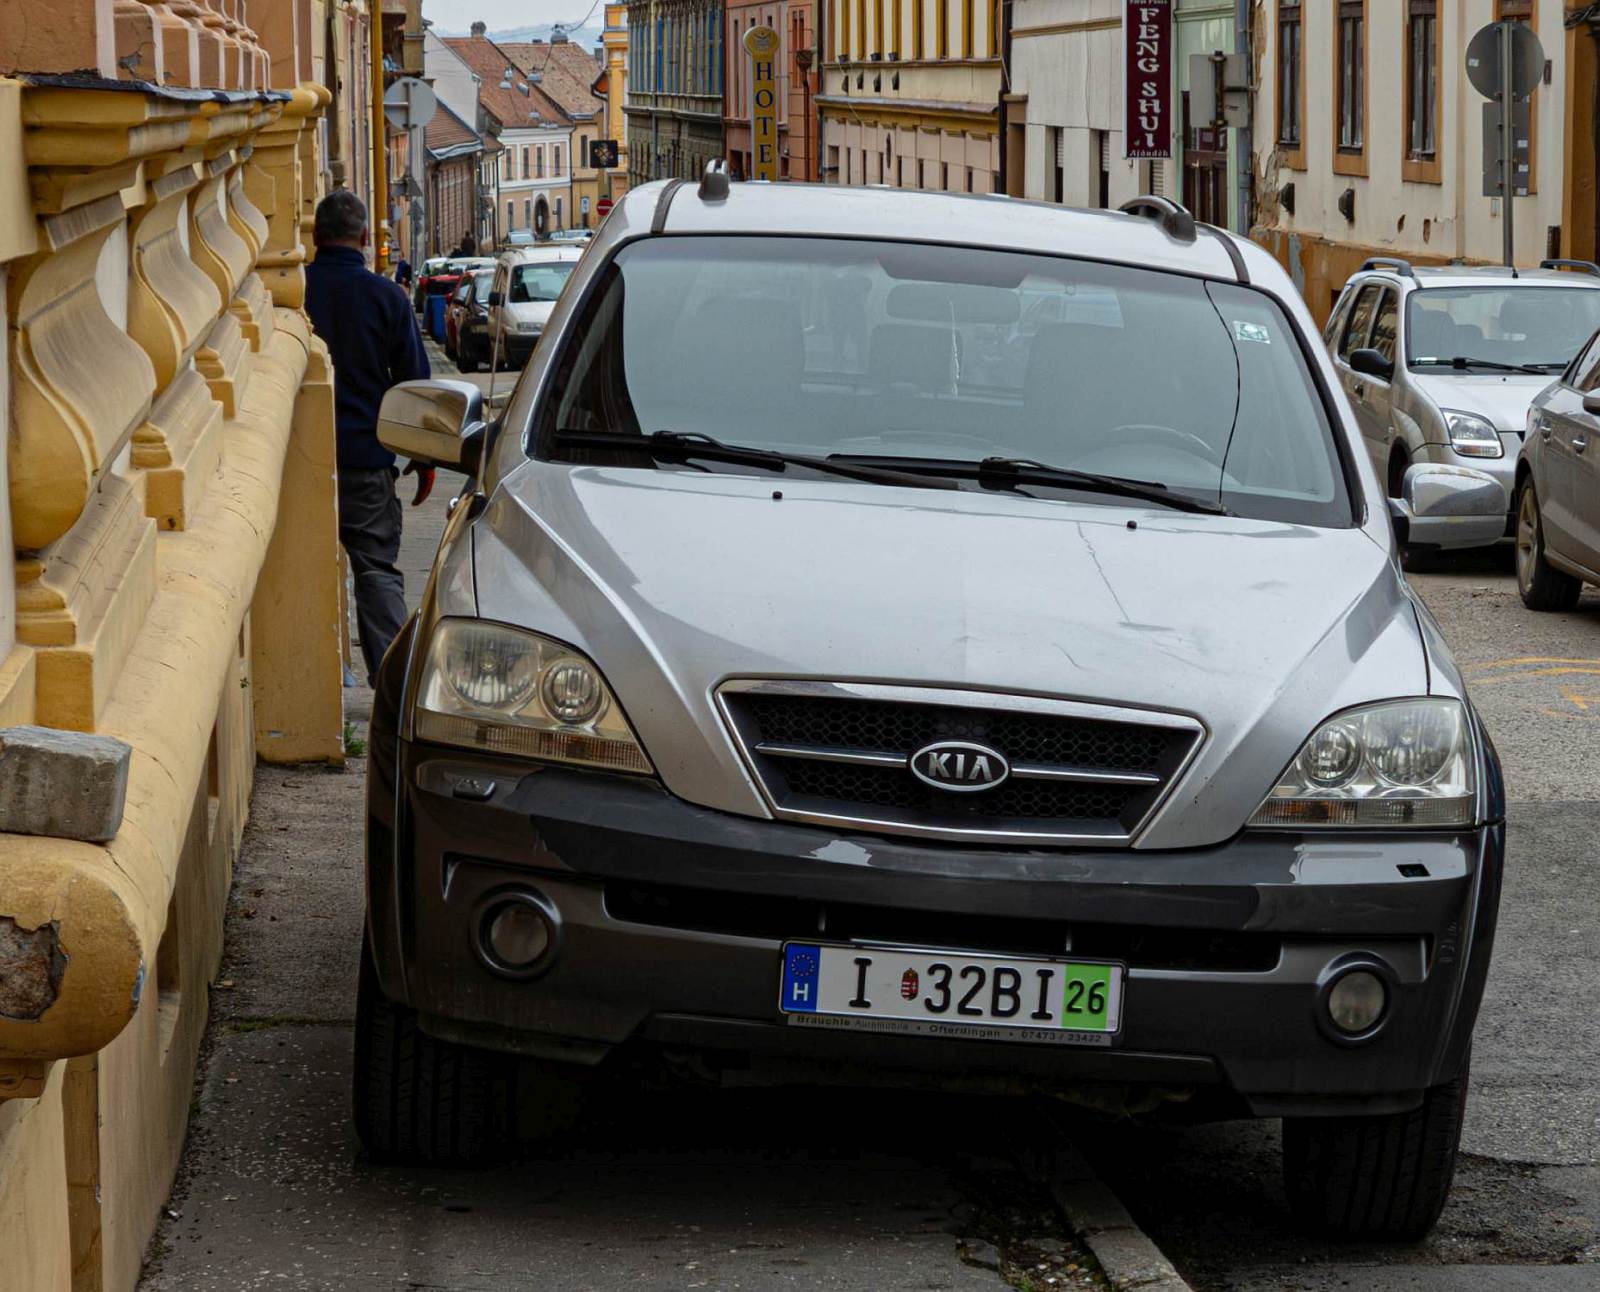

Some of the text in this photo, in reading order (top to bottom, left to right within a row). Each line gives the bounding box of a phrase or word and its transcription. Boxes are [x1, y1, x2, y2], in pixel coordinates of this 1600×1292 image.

[1136, 8, 1160, 73] FENG
[1138, 81, 1161, 147] SHUI
[928, 752, 993, 781] KIA
[793, 982, 809, 1001] H
[923, 963, 1055, 1020] 32BI
[1066, 980, 1106, 1015] 26
